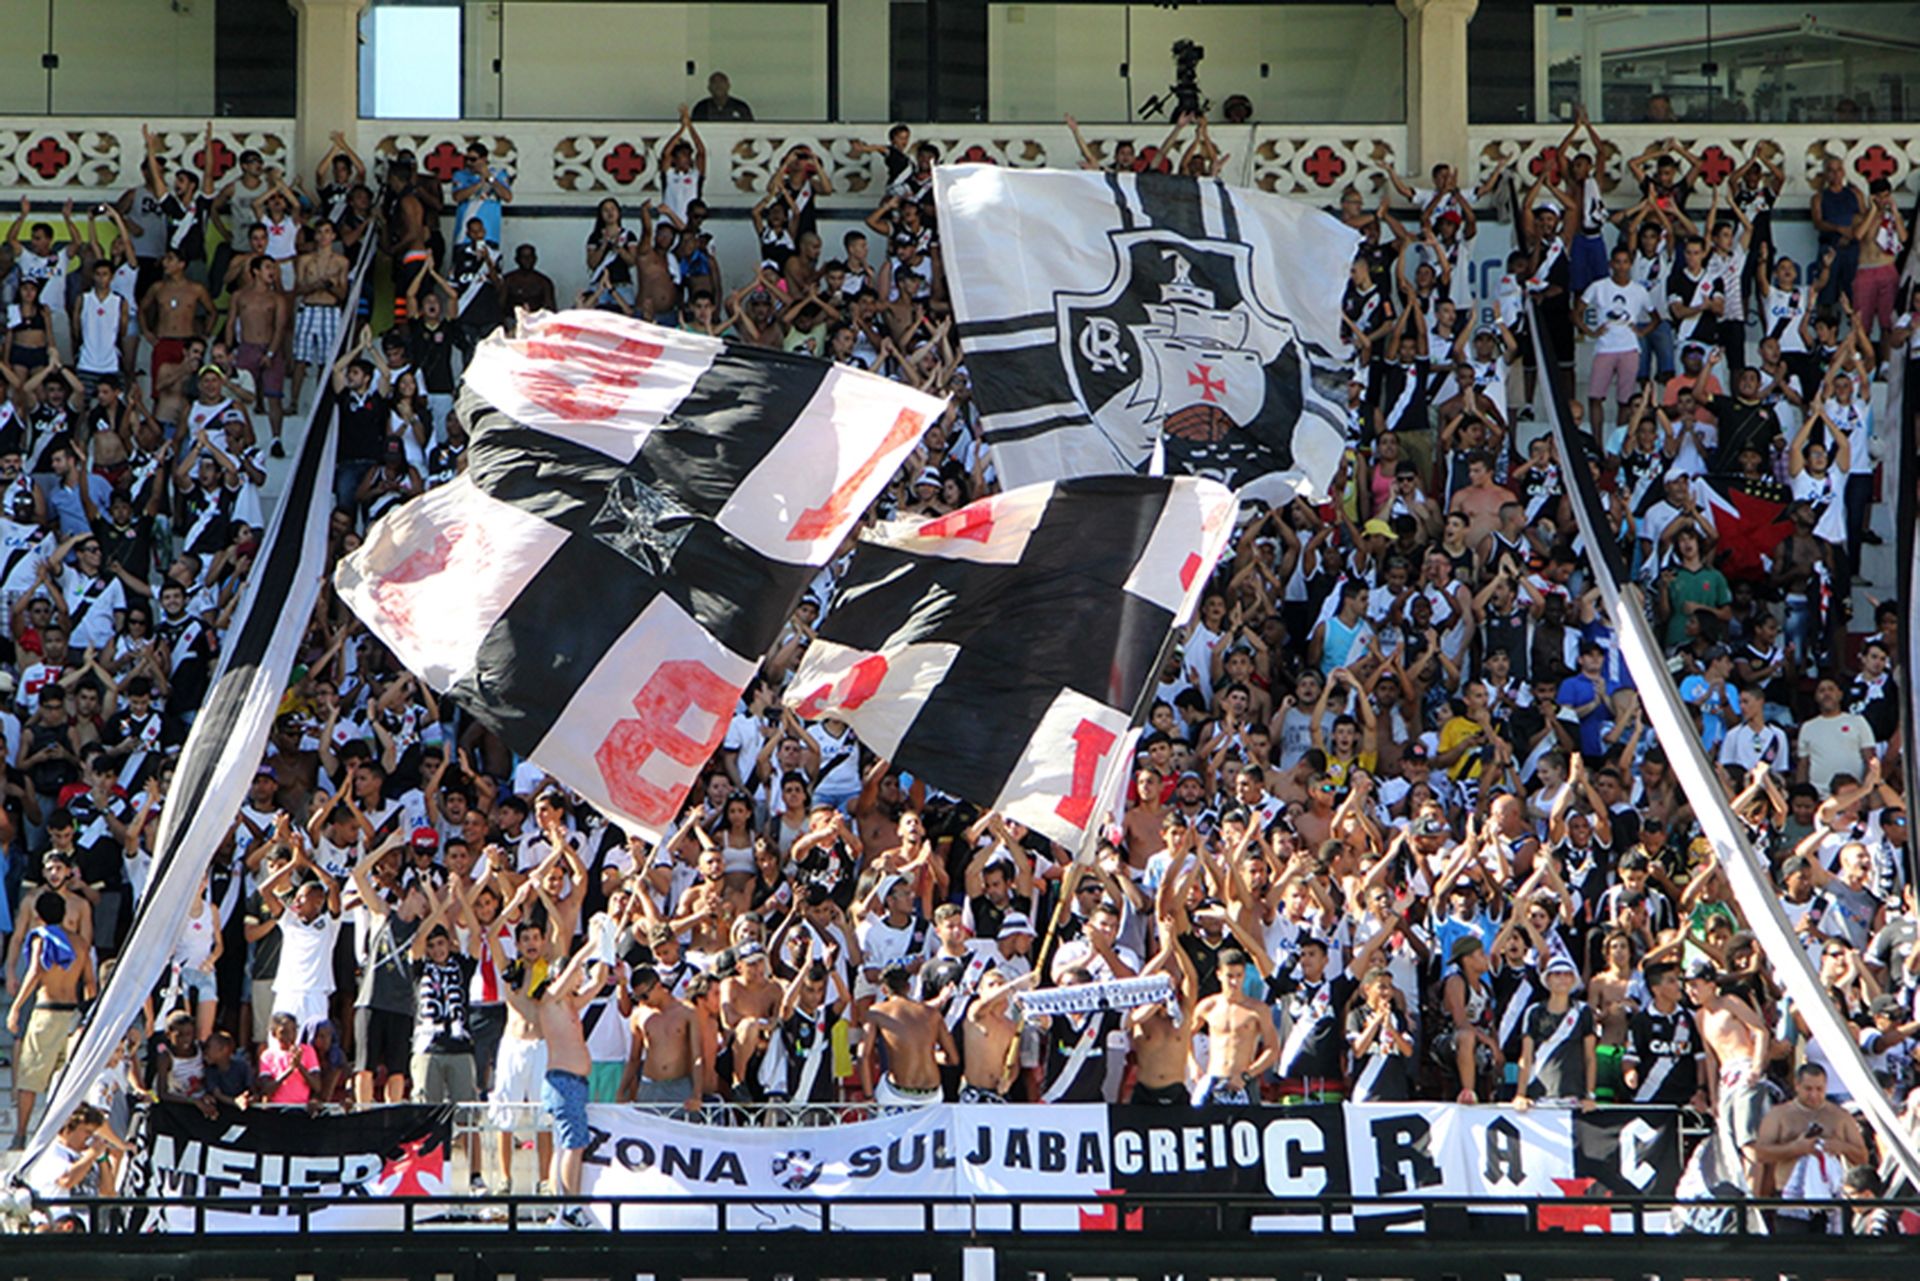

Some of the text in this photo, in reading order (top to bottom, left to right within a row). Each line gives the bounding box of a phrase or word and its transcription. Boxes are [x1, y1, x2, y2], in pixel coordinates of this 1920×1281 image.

[150, 1123, 389, 1216] MÉIER
[583, 1126, 956, 1186] ZONA SUL
[966, 1120, 1260, 1174] JABA CREIO
